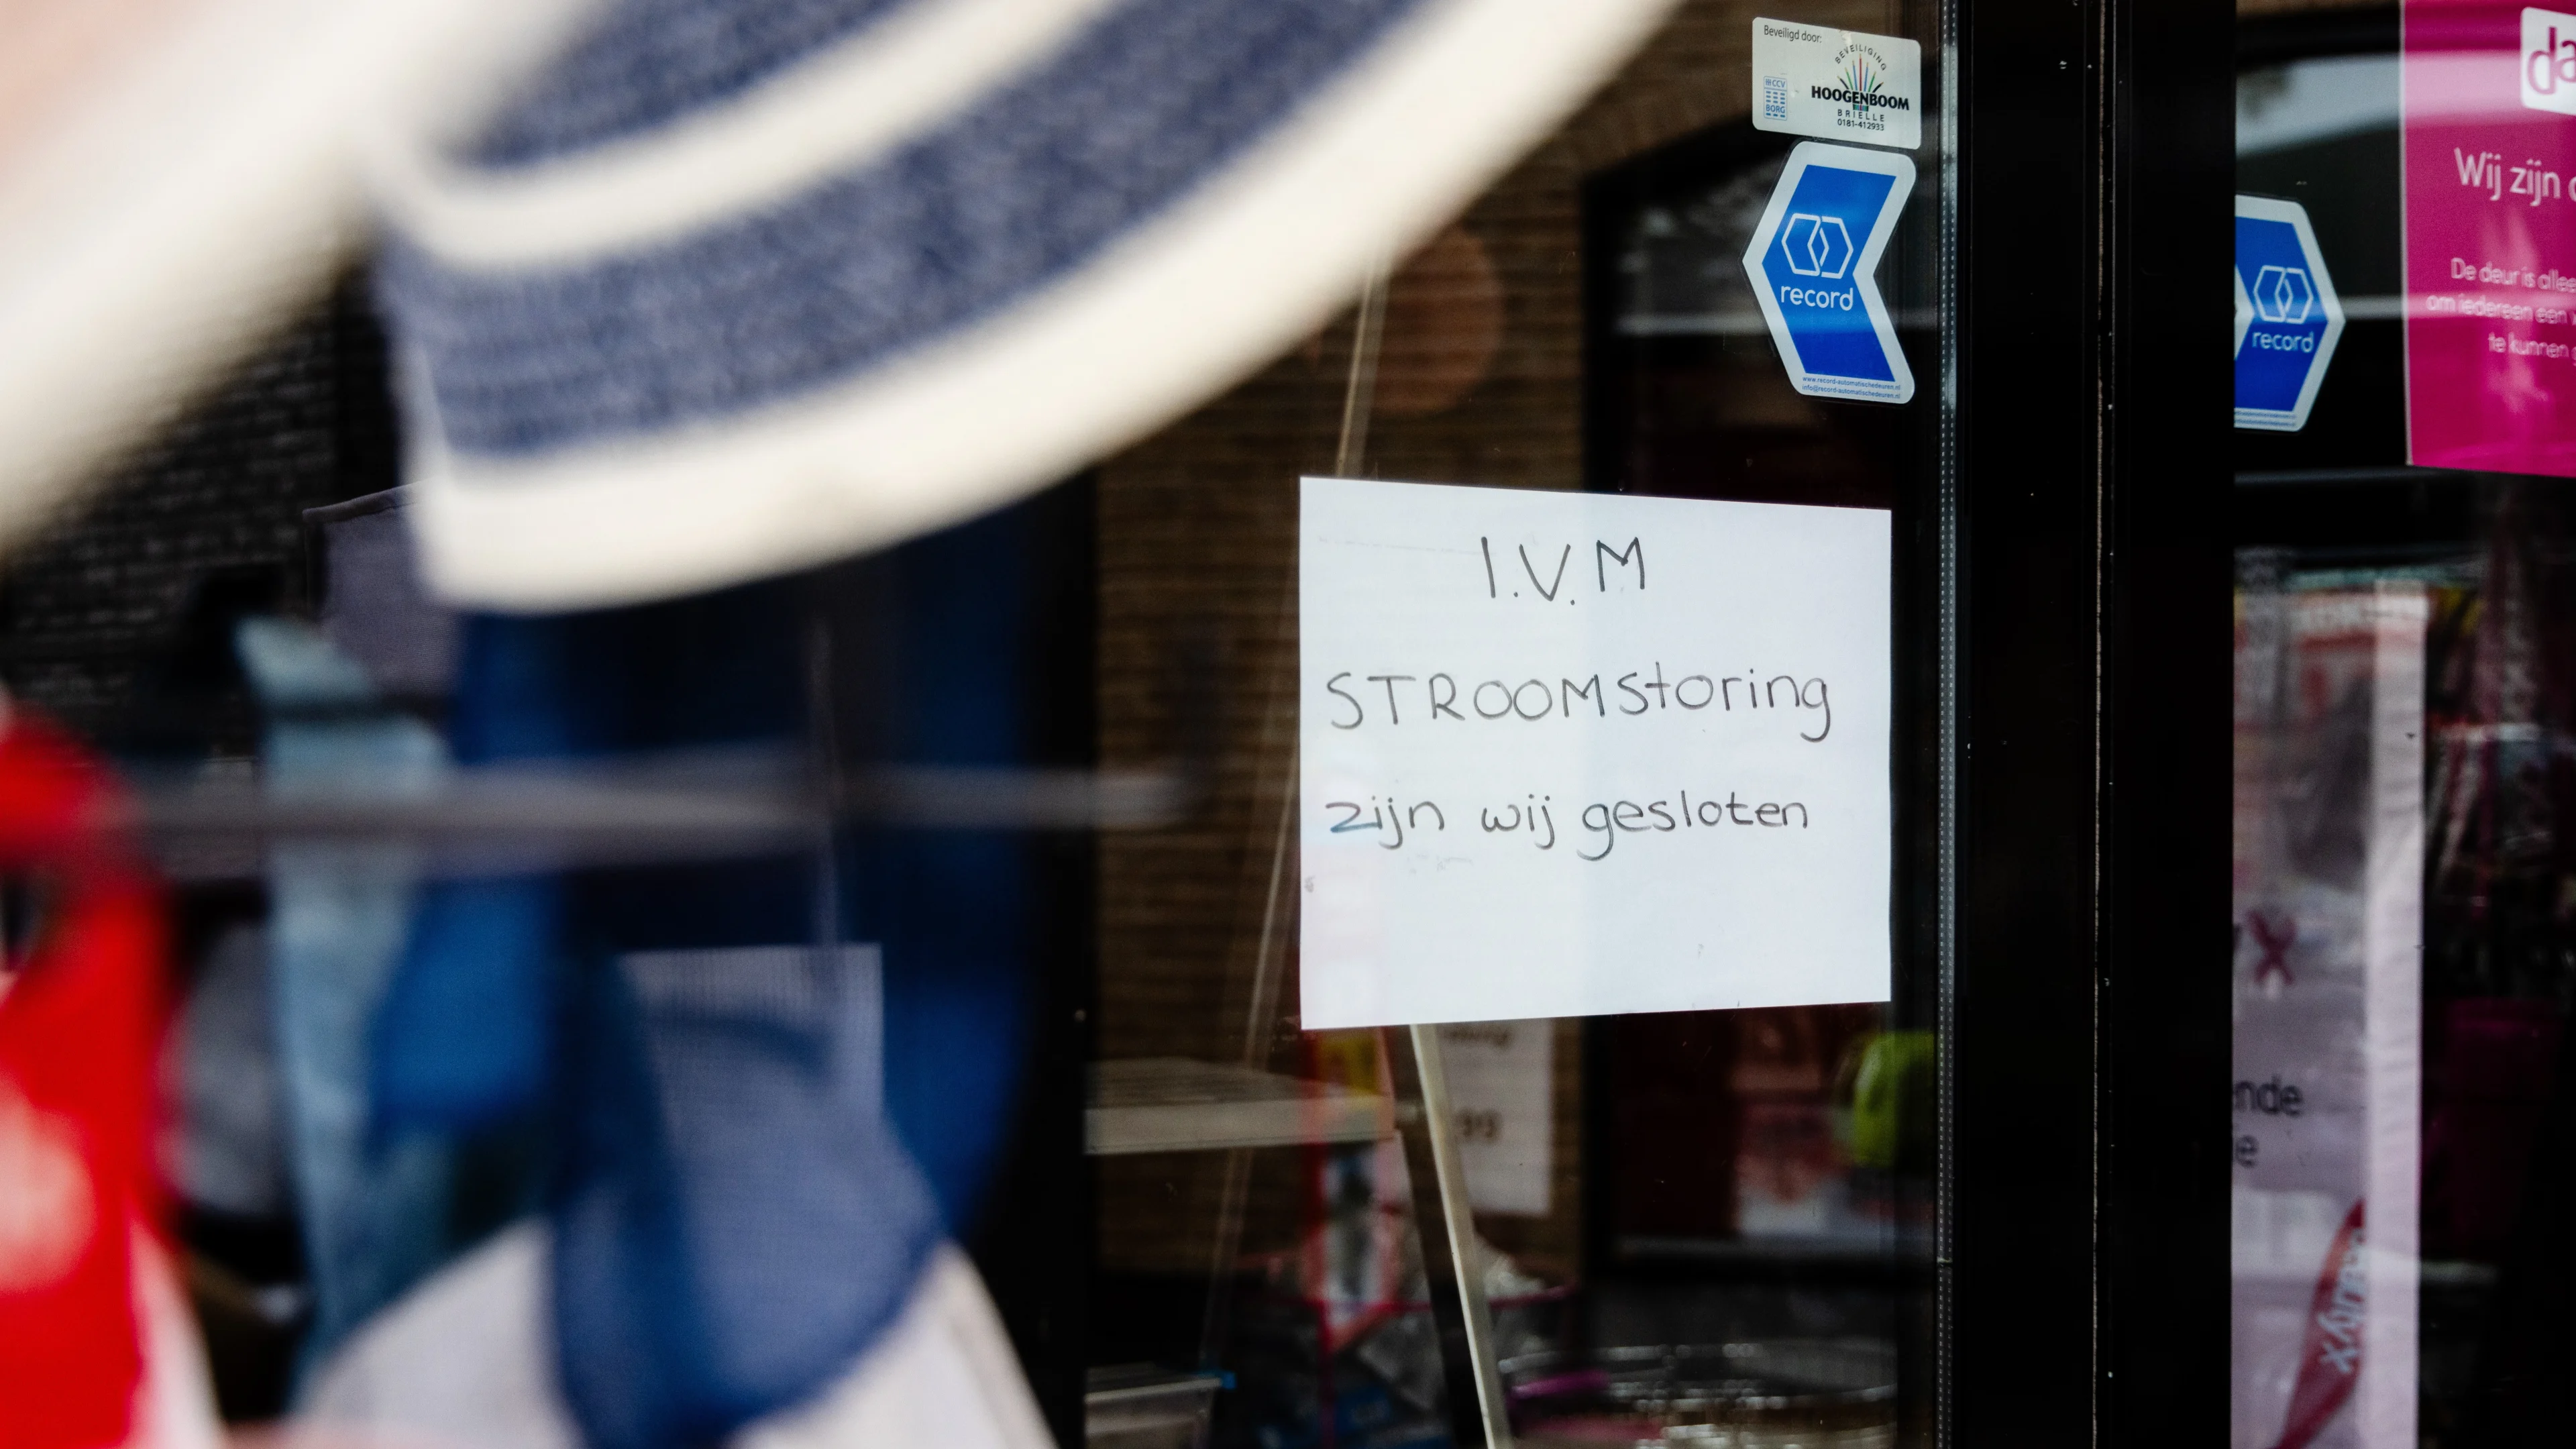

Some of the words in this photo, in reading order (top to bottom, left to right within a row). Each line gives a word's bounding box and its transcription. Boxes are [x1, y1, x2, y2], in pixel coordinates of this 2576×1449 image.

[1764, 25, 1799, 41] Beveiligd
[1801, 32, 1822, 43] door:
[1835, 44, 1886, 71] BEVEILIGING
[1772, 79, 1785, 88] CCV
[1766, 104, 1785, 113] BORG
[1811, 85, 1909, 111] HOOGENBOOM
[1837, 109, 1884, 122] BRIELLE
[1837, 119, 1884, 131] 0181-412933
[2454, 147, 2502, 201] Wij
[2509, 158, 2561, 207] zijn
[2451, 257, 2477, 280] De
[2479, 261, 2520, 285] deur
[2521, 266, 2536, 288] is
[1780, 284, 1853, 311] record
[2426, 294, 2456, 312] om
[2458, 292, 2533, 321] iedereen
[2534, 307, 2567, 325] een
[2252, 331, 2314, 353] record
[2487, 331, 2507, 354] te
[2508, 331, 2569, 358] kunnen
[1802, 384, 1900, 399] info@record-automatischedeuren.nl
[1803, 376, 1900, 390] www.record-automatischedeuren.nl
[1325, 794, 1445, 850] zijn
[1481, 794, 1555, 850] wij
[1577, 790, 1808, 862] gesloten
